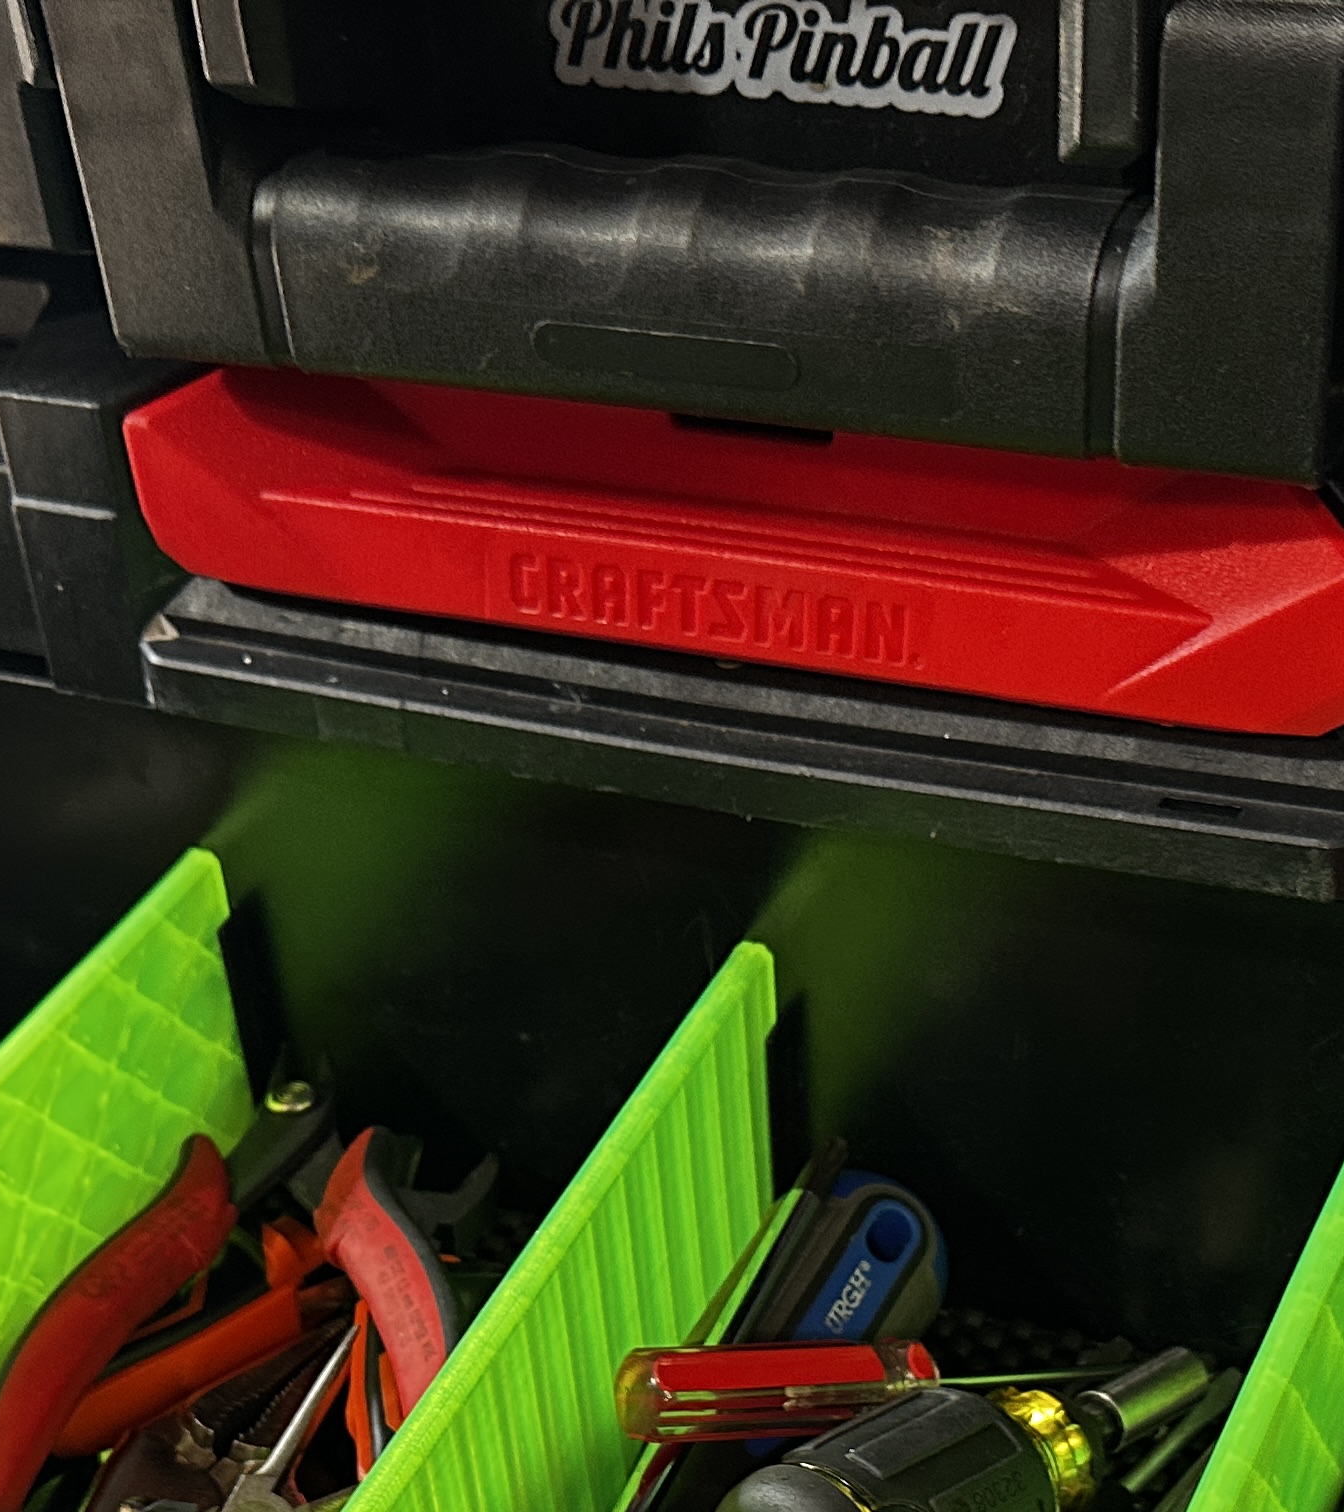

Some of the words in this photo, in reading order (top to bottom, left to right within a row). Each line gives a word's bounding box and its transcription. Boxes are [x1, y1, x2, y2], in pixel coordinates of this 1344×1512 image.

[560, 0, 726, 75] Phils
[744, 9, 1003, 97] Pinball
[508, 552, 912, 668] CRAFTSMAN
